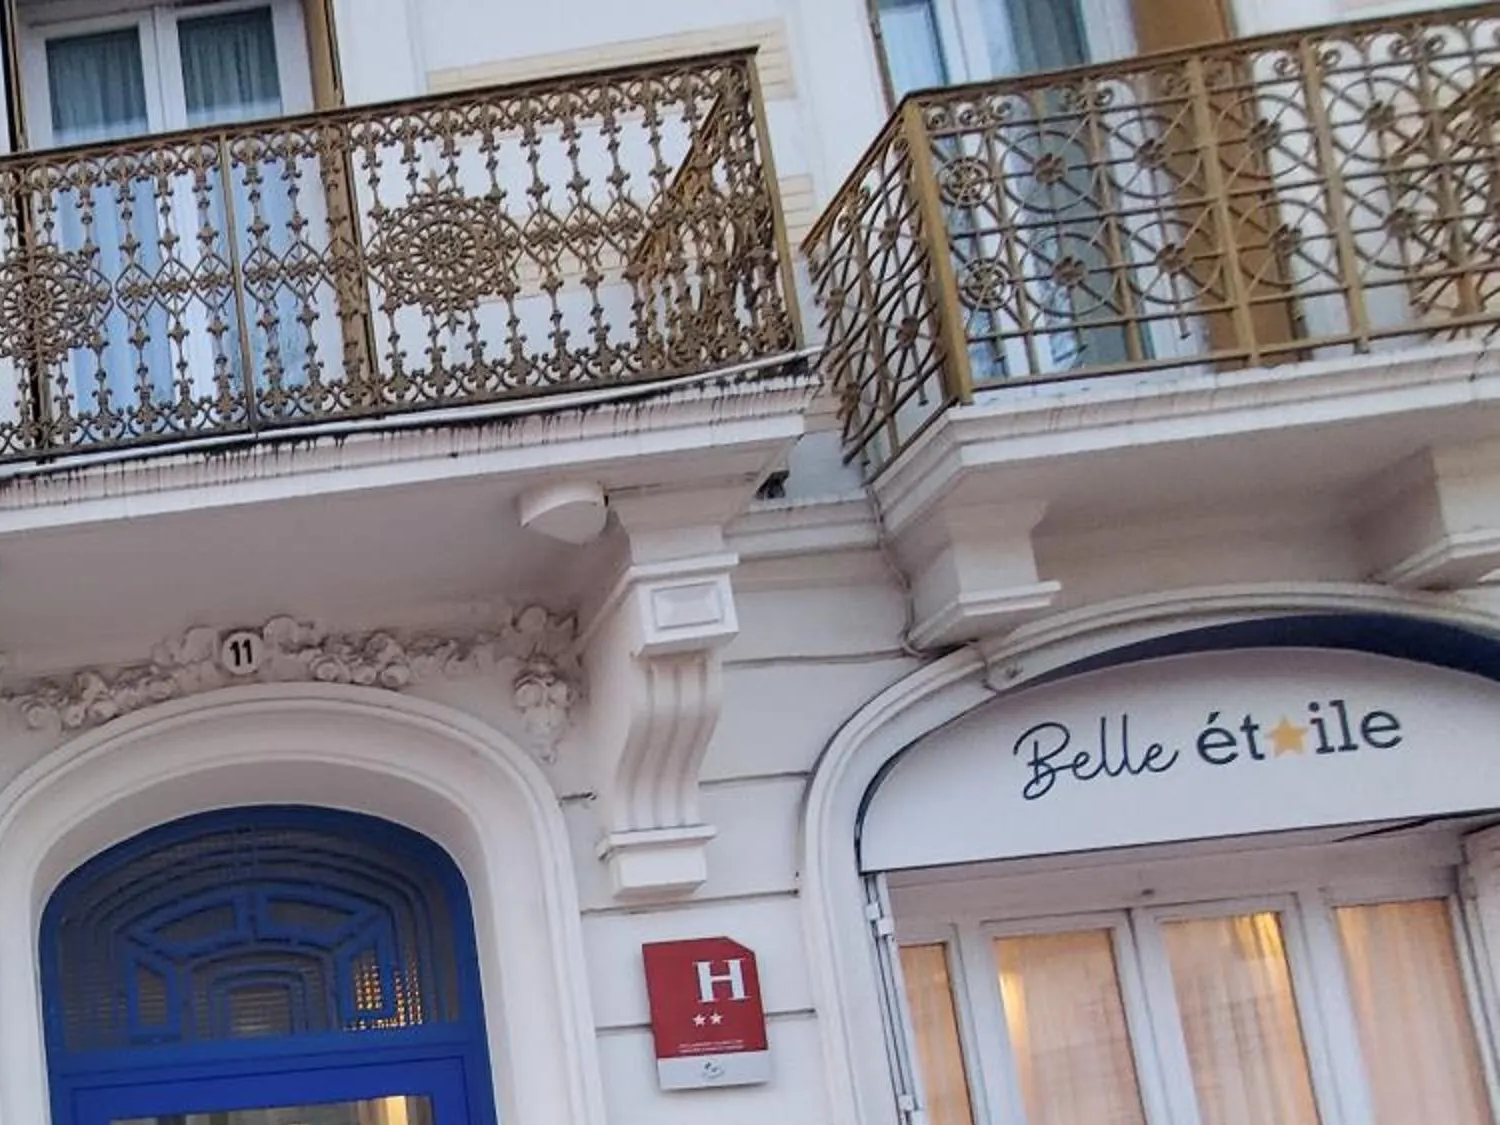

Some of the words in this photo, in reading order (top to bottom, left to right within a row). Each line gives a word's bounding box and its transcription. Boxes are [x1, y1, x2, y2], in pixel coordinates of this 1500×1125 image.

[229, 639, 253, 667] 11
[1013, 712, 1179, 800] Belle
[693, 958, 752, 1004] H
